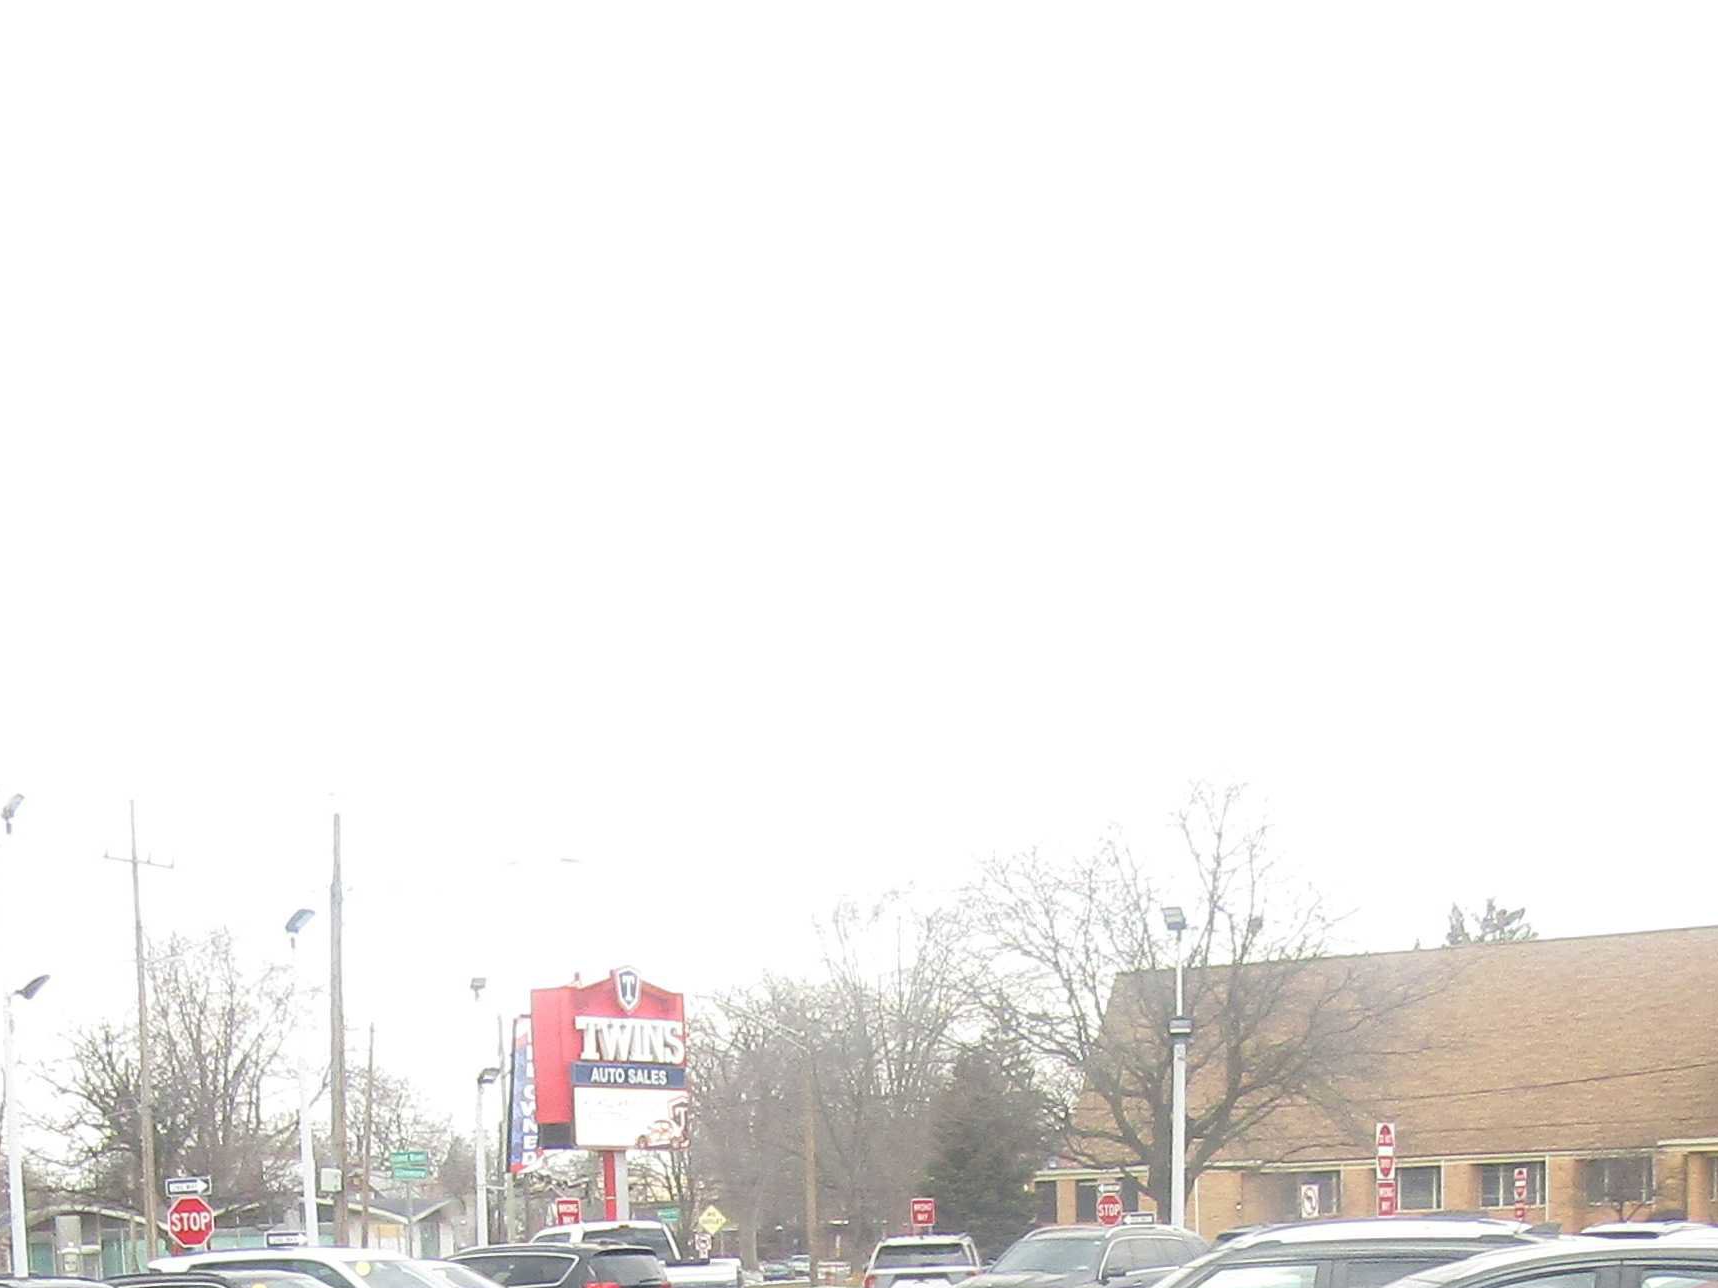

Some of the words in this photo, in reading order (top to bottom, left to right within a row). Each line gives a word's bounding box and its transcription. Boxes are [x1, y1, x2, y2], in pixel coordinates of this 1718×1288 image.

[574, 1016, 685, 1064] TWINS
[590, 1067, 625, 1083] AUTO
[628, 1068, 668, 1085] SALES
[1098, 1204, 1120, 1216] STOP
[171, 1212, 210, 1232] STOP
